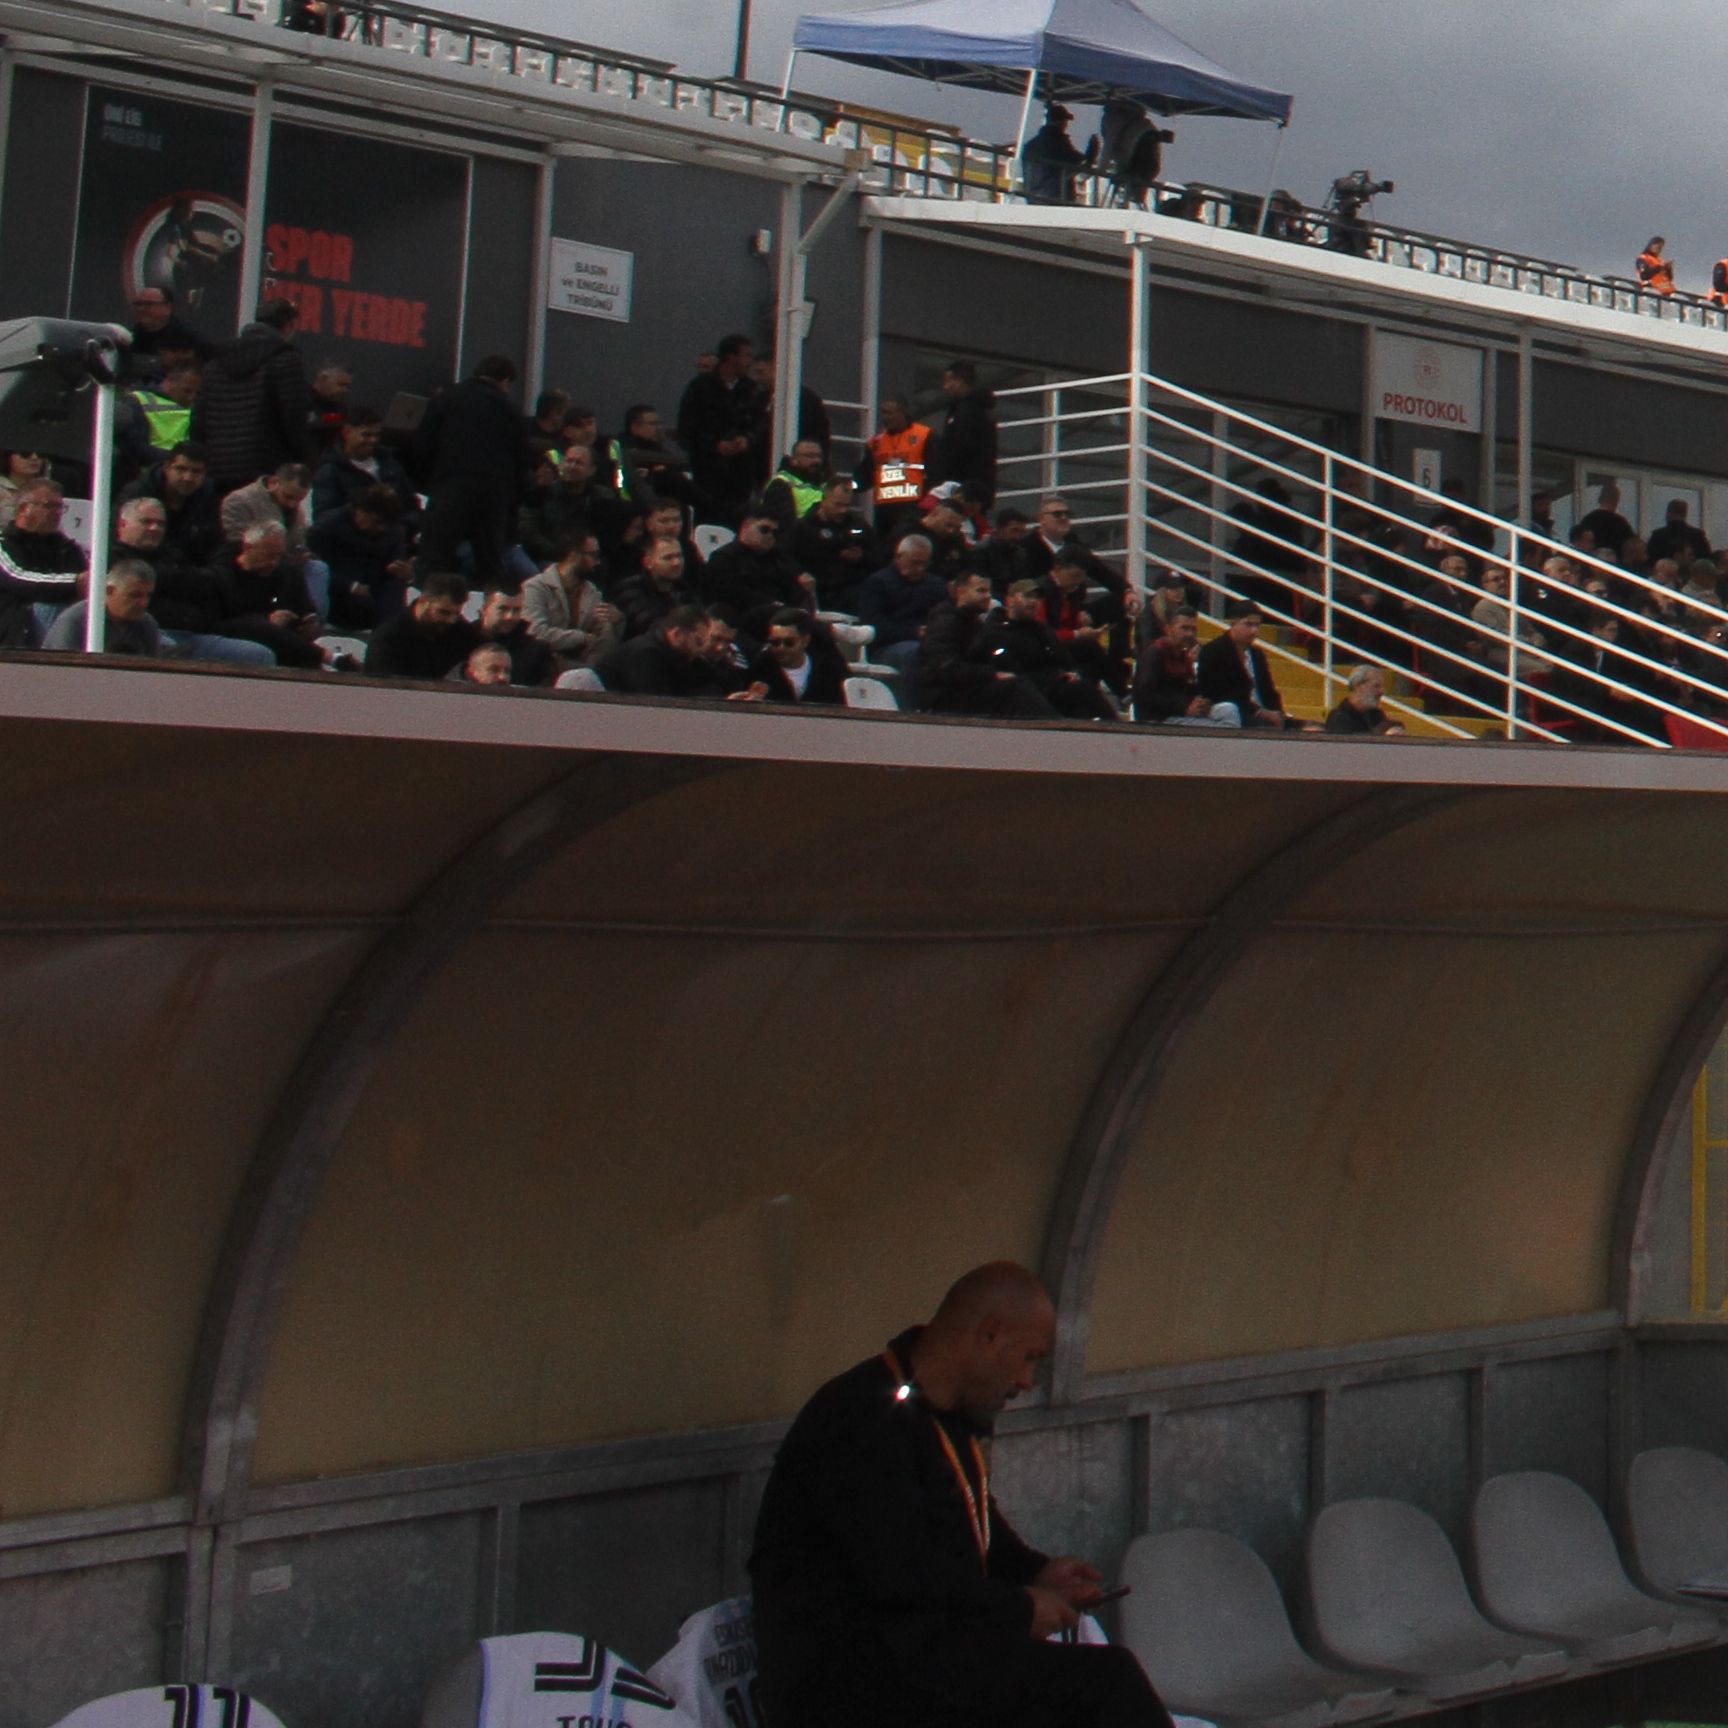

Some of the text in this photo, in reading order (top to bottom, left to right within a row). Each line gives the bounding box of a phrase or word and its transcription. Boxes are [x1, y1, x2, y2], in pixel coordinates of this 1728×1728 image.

[266, 224, 354, 283] SPOR
[331, 287, 427, 348] YERDE
[1383, 392, 1467, 424] PROTOKOL
